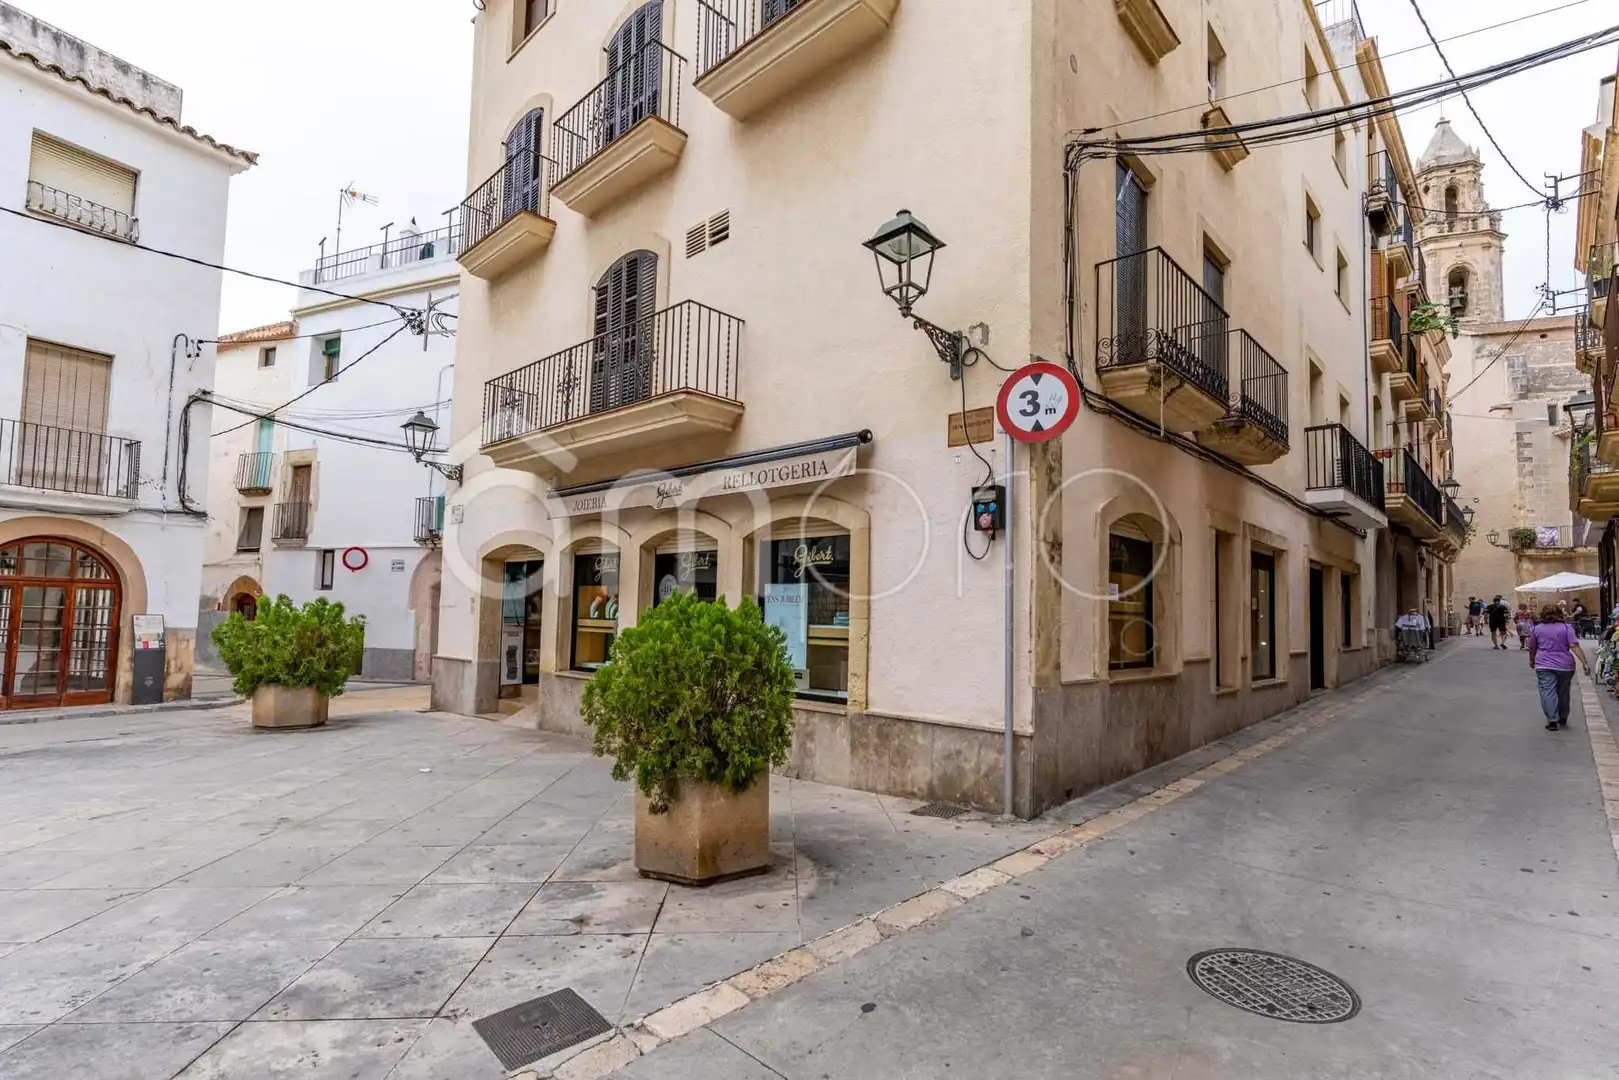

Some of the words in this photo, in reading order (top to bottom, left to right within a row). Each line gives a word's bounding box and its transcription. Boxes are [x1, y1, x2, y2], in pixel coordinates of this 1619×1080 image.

[1019, 390, 1041, 417] 3
[1045, 407, 1057, 415] m
[573, 496, 608, 512] JOIERIA
[722, 459, 829, 490] RELLOTGERIA
